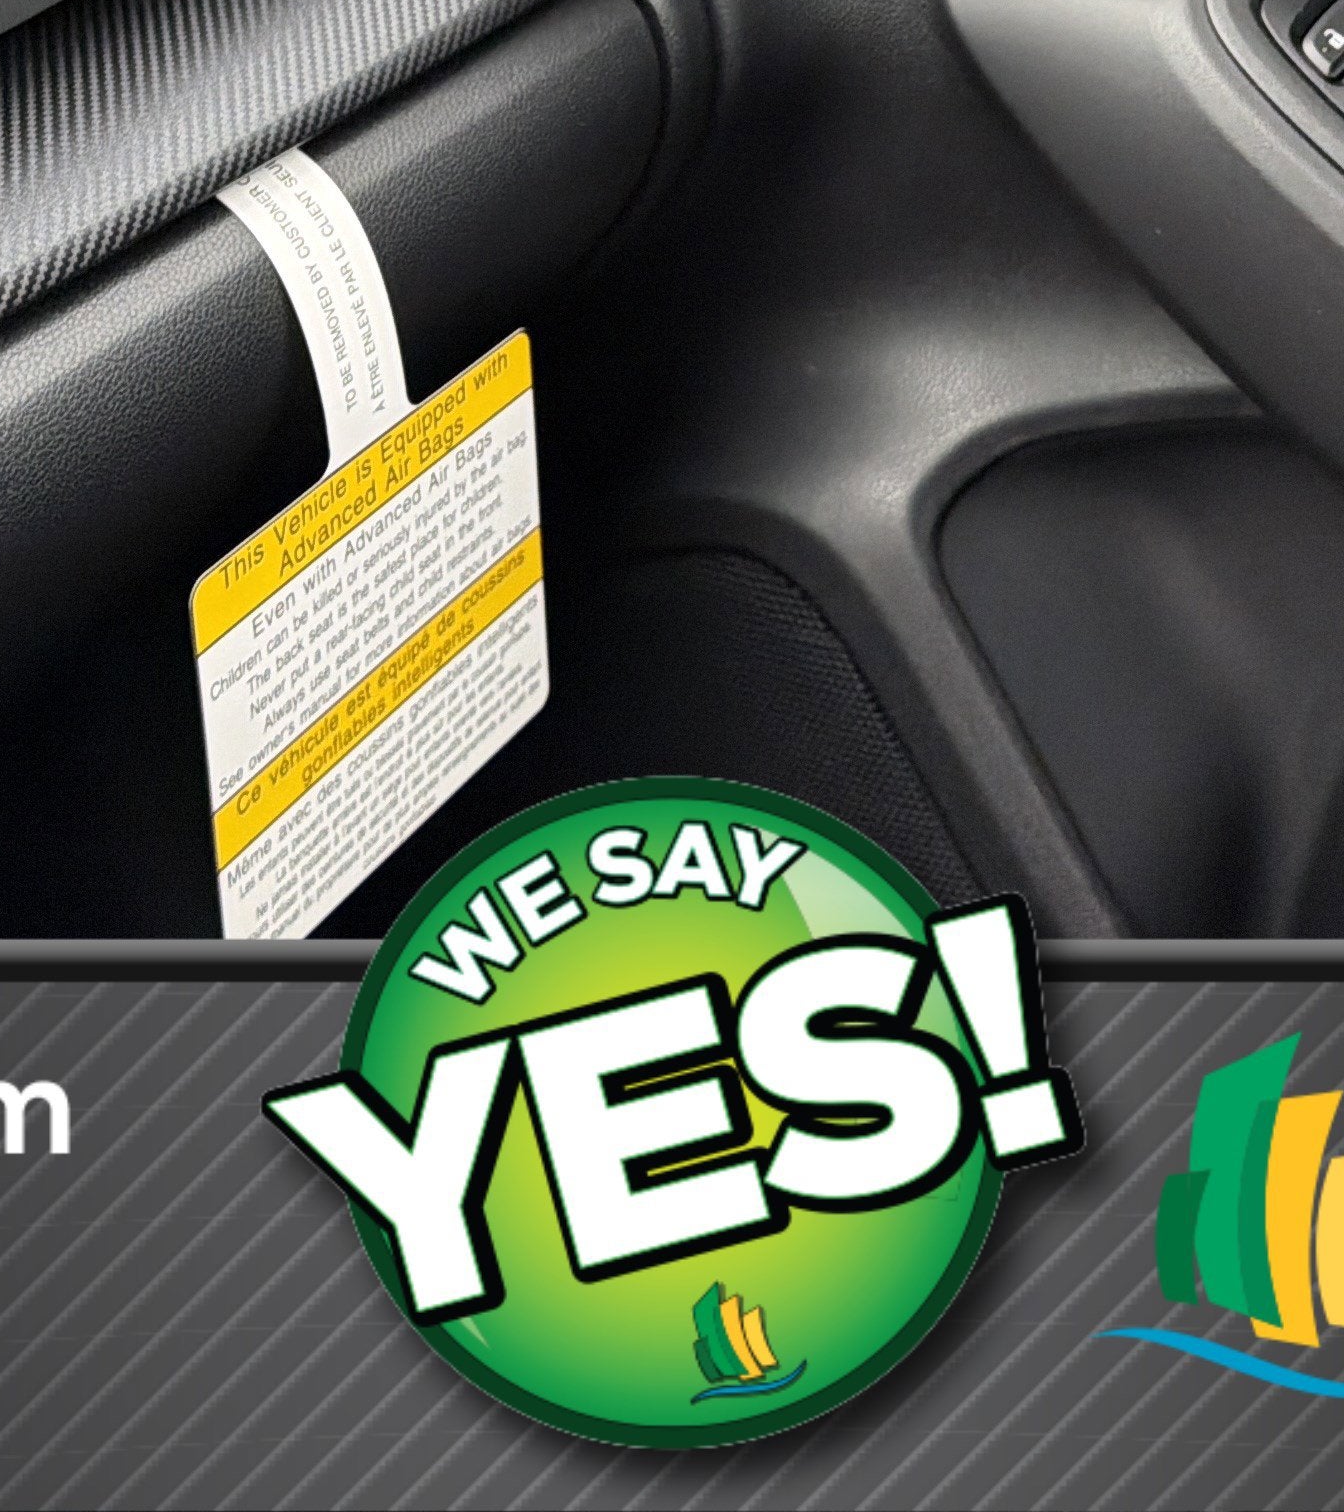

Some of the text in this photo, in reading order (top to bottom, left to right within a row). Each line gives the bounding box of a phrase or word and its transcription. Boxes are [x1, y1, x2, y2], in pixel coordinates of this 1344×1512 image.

[248, 183, 311, 260] CUSTOMER
[293, 189, 335, 238] CLIENT
[304, 262, 324, 285] BY
[328, 237, 347, 262] LE
[339, 260, 360, 296] PAR
[316, 286, 349, 363] REMOVED
[339, 361, 354, 387] BE
[344, 388, 358, 413] TO
[217, 353, 508, 590] This Vehicle is Equipped with
[251, 431, 493, 639] Even with Advanced Air Bags
[279, 416, 464, 577] Advanced Air Bags
[209, 649, 262, 702] Children
[266, 626, 289, 655] can
[292, 610, 309, 633] be
[312, 577, 343, 615] killed
[346, 567, 359, 587] or
[362, 525, 411, 574] seriously
[414, 488, 451, 530] injured
[453, 479, 467, 498] by
[470, 462, 487, 484] the
[490, 447, 504, 468] air
[246, 667, 271, 695] The
[275, 638, 305, 673] back
[308, 611, 334, 645] seat
[337, 601, 348, 619] is
[351, 583, 370, 607] the
[373, 549, 407, 589] safest
[410, 524, 439, 561] place
[442, 508, 457, 530] for
[249, 678, 286, 720] Never
[290, 656, 310, 689] put
[313, 648, 322, 665] a
[325, 593, 386, 654] rear-facing
[389, 565, 415, 599] child
[418, 544, 442, 575] seat
[444, 535, 455, 552] in
[458, 518, 475, 540] the
[263, 687, 306, 733] Always
[310, 665, 331, 693] use
[335, 637, 360, 670] seat
[363, 613, 390, 645] belts
[393, 589, 415, 619] and
[418, 565, 444, 598] child
[218, 767, 244, 798] See
[248, 720, 296, 771] owner's
[299, 675, 342, 725] manual
[345, 661, 361, 683] for
[364, 634, 394, 667] more
[234, 772, 262, 816] Ce
[266, 713, 339, 786] véhicule
[345, 682, 371, 717] est
[377, 630, 431, 689] équipé
[436, 610, 456, 637] de
[461, 549, 525, 615] coussins
[301, 696, 387, 788] gonflables
[392, 617, 475, 702] intelligents
[227, 838, 272, 889] Même
[278, 800, 312, 843] avec
[316, 773, 343, 805] des
[346, 715, 405, 777] coussins
